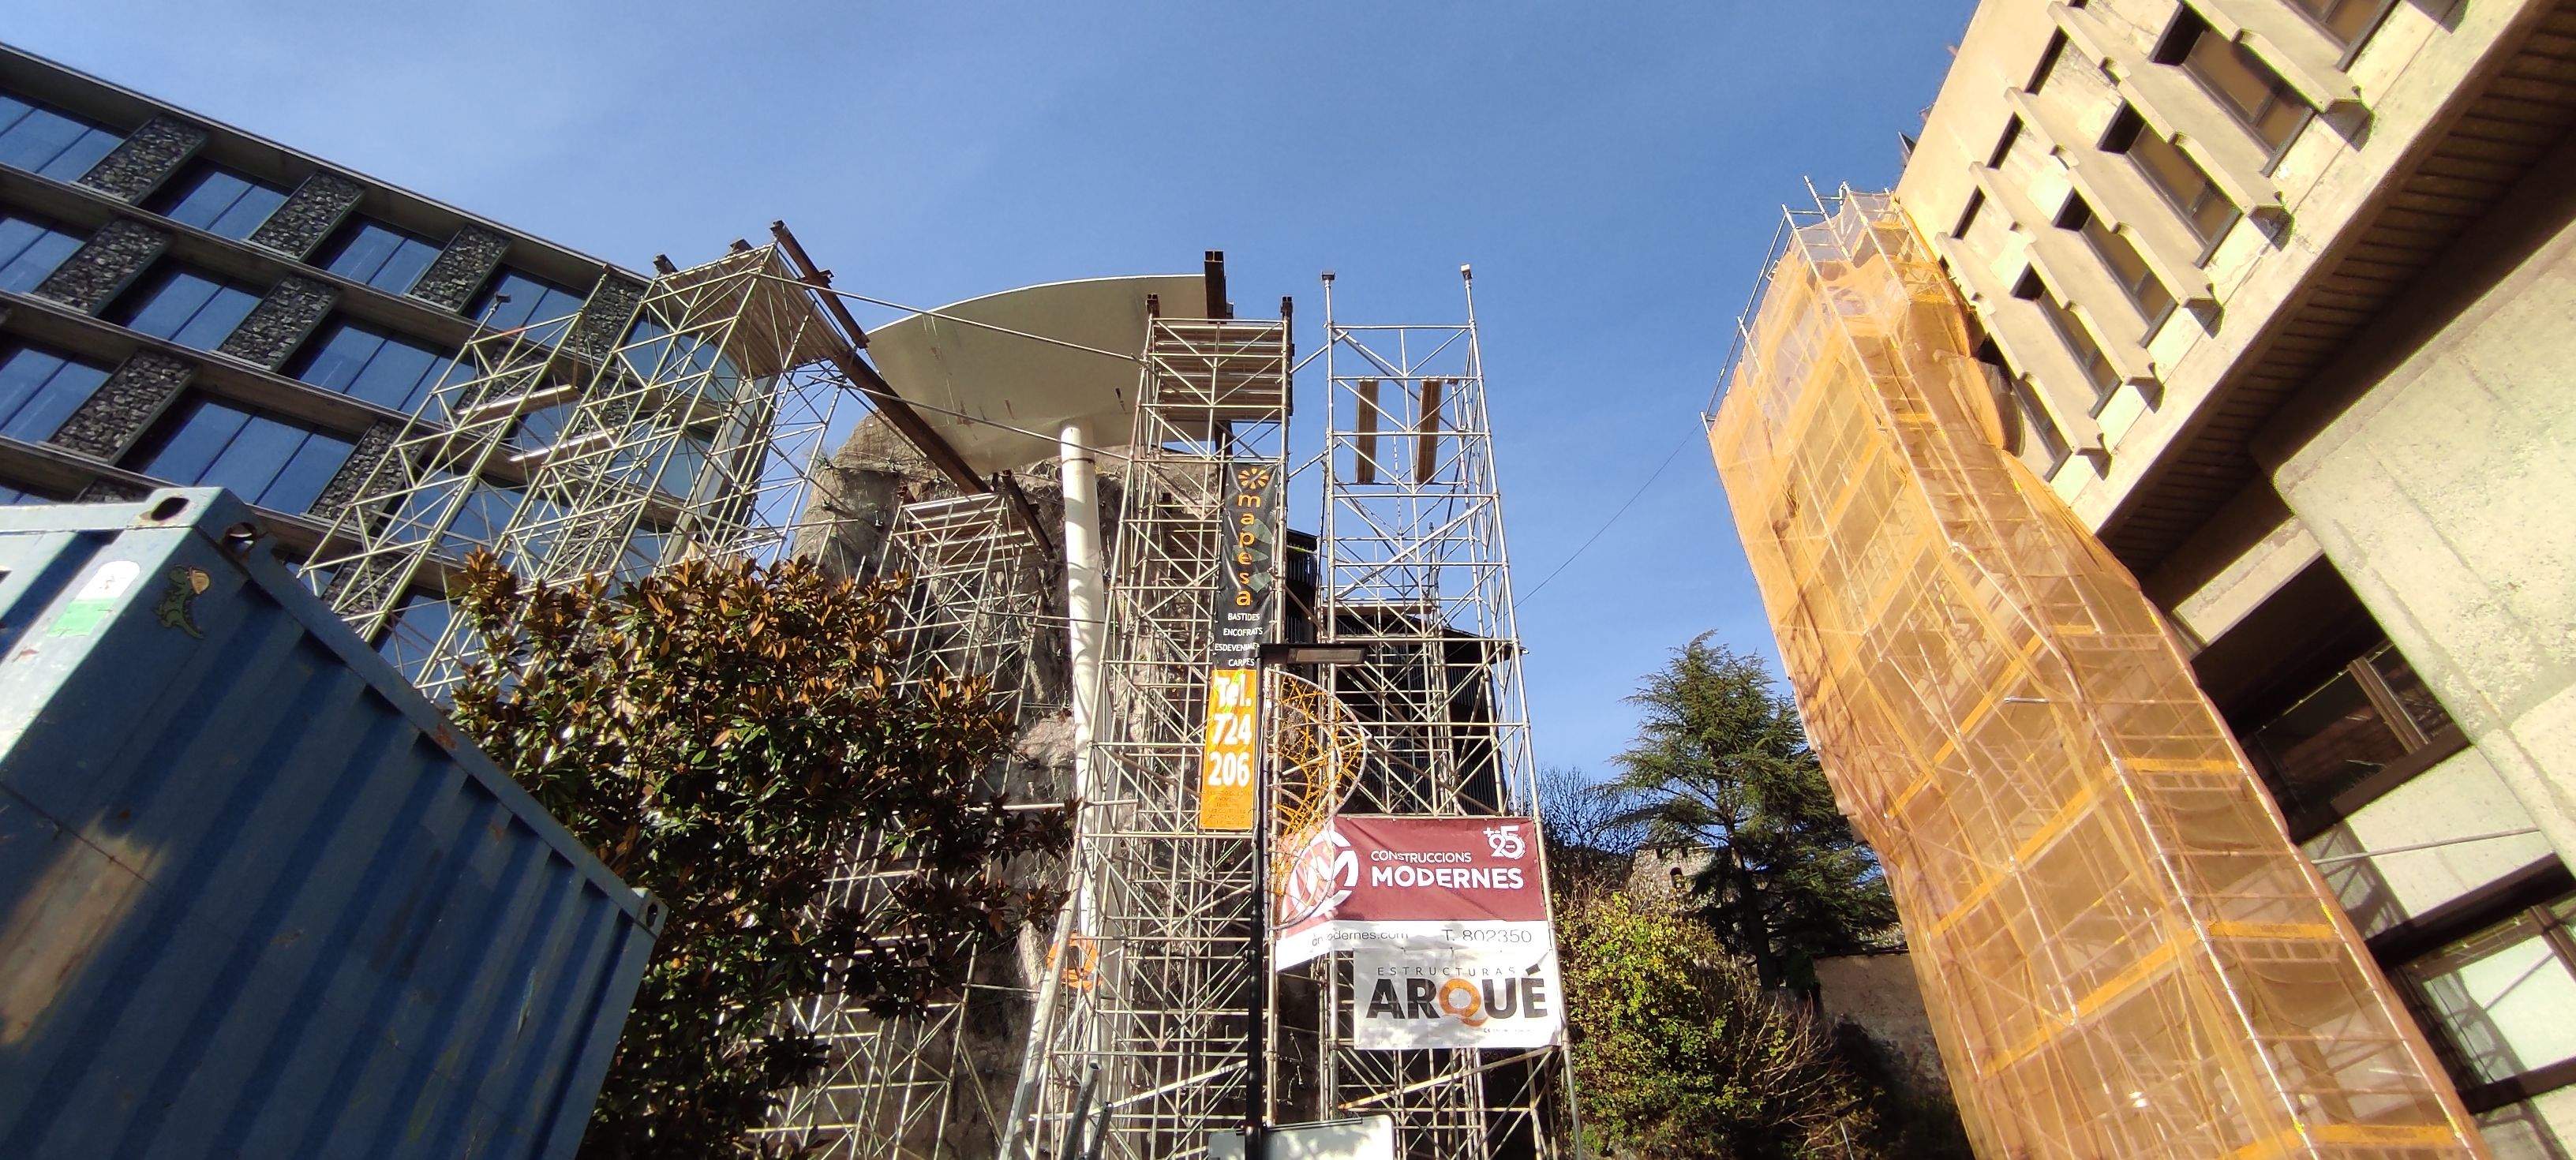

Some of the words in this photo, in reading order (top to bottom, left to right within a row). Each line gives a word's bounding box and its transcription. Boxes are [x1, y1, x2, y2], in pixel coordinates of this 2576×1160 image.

[1236, 494, 1261, 607] mapesa
[1227, 612, 1260, 622] BASTIDES
[1222, 627, 1263, 637] ENCOFRATS
[1228, 658, 1255, 667] CARPES
[1218, 674, 1252, 707] Tel.
[1212, 713, 1252, 746] 724
[1208, 751, 1251, 788] 206
[1370, 850, 1472, 863] CONSTRUCCIONS
[1371, 865, 1524, 889] MODERNES
[1441, 929, 1455, 941] T.
[1462, 930, 1532, 943] 802350
[1377, 967, 1515, 977] ESTRUCTURAS
[1366, 964, 1548, 1027] ARQUÉ
